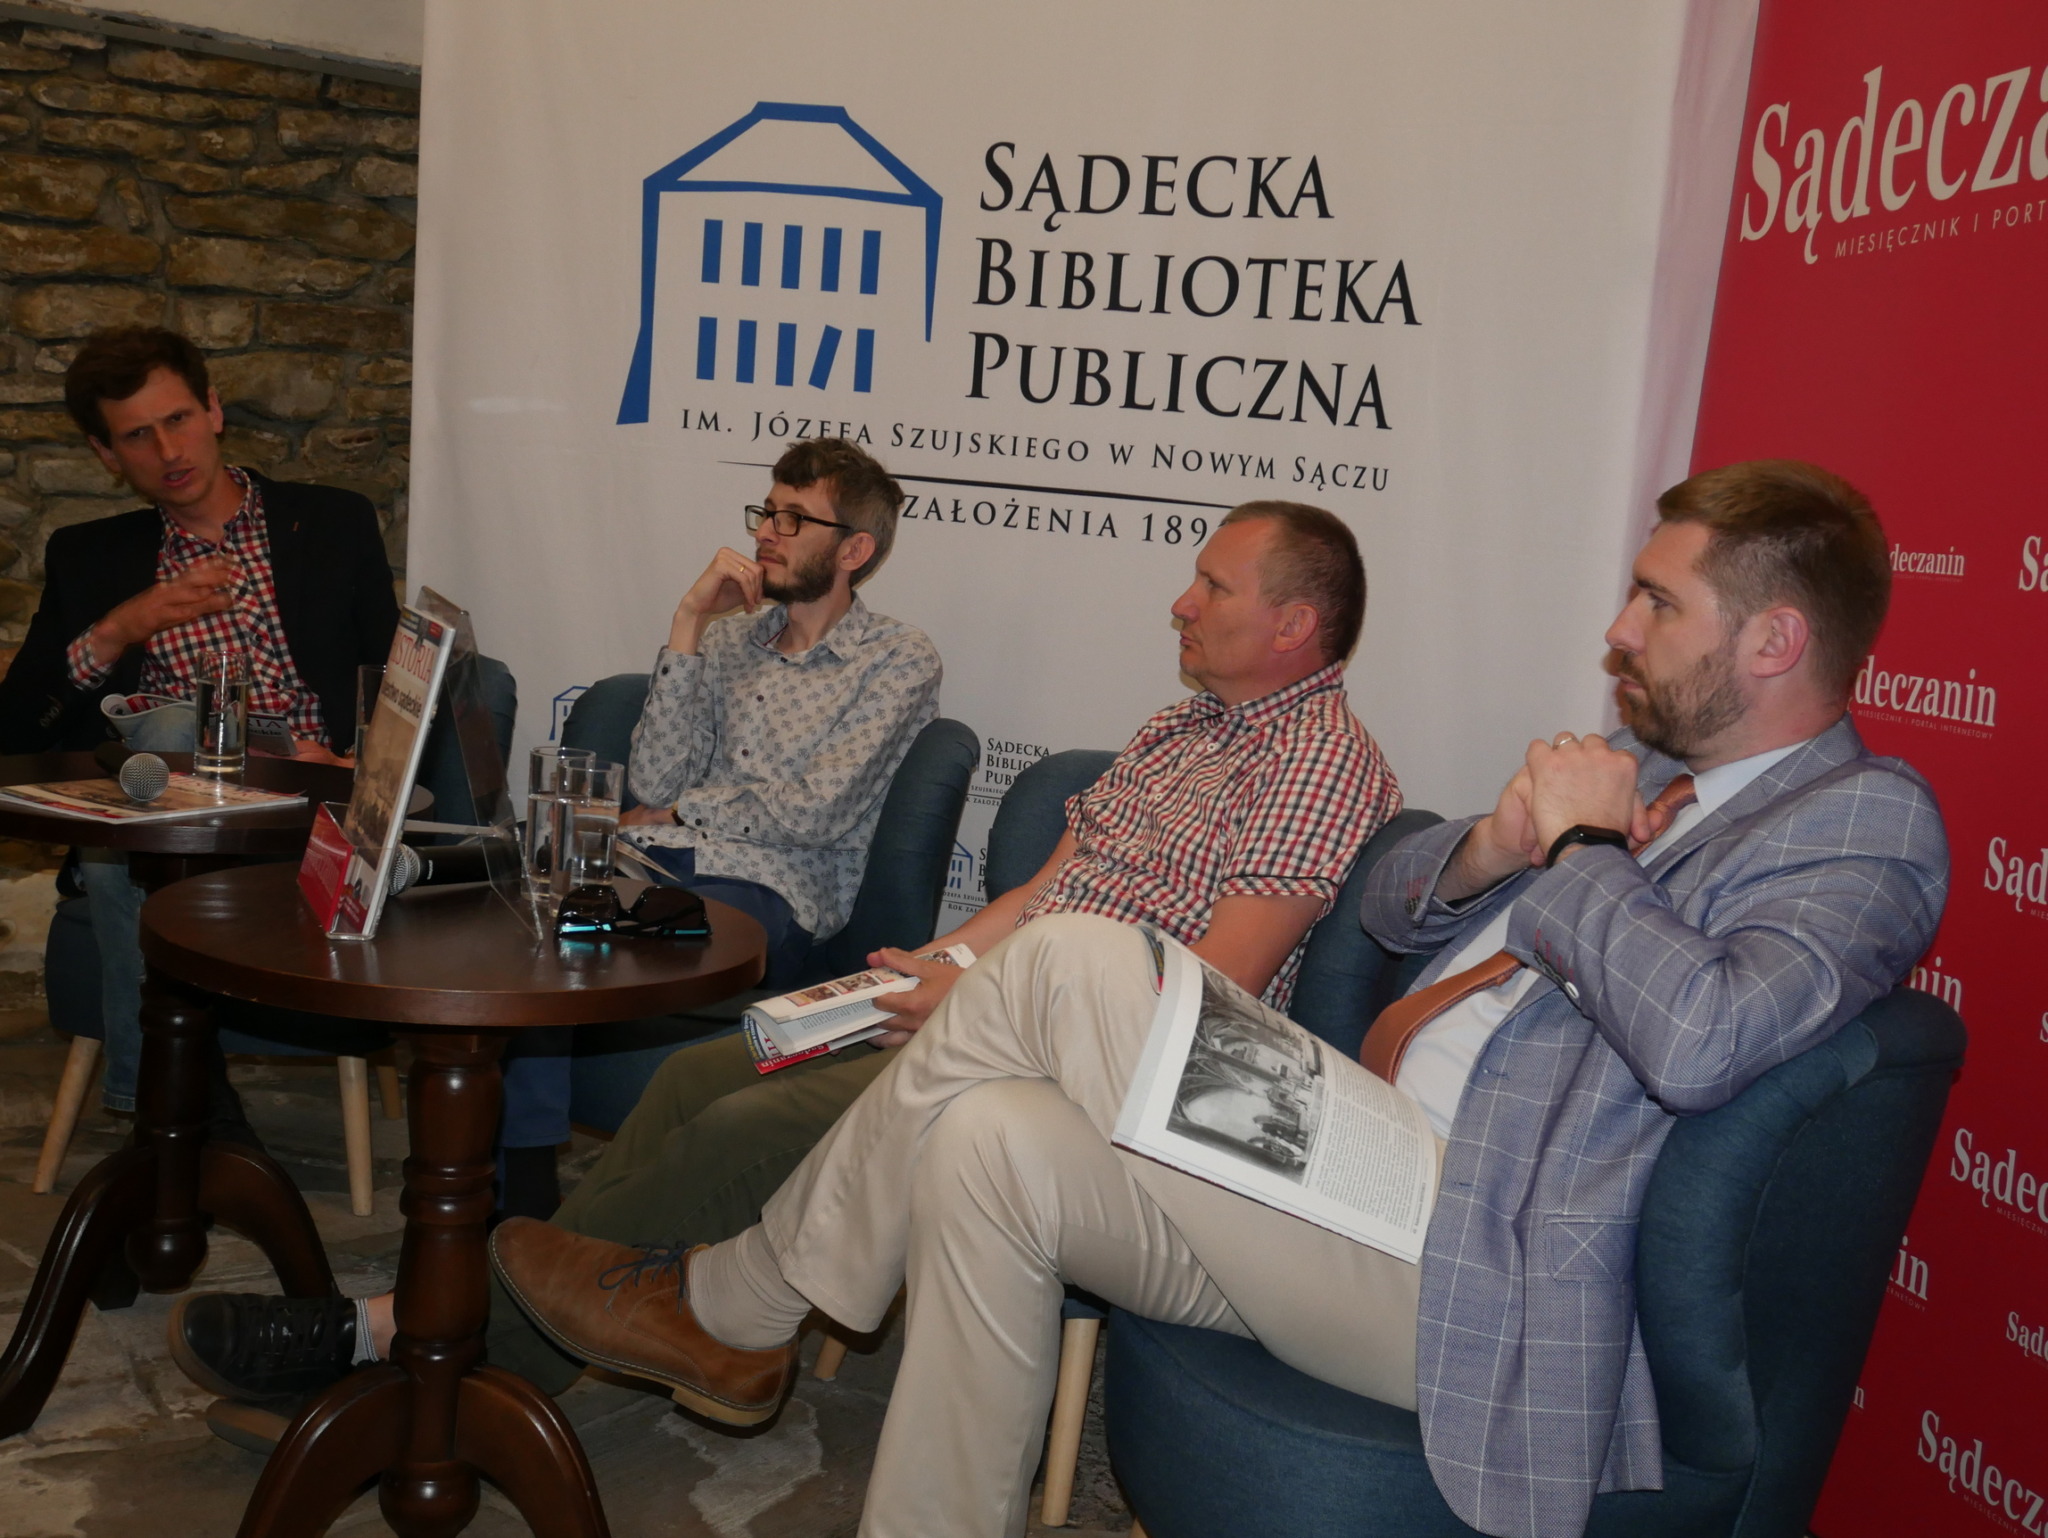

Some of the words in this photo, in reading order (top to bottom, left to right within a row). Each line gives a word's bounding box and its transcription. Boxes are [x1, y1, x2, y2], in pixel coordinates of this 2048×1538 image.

[979, 141, 1335, 233] SĄDECKA
[1834, 215, 1961, 259] MIESIĘCZNIK
[1972, 212, 1979, 233] I
[1992, 199, 2047, 230] PORT
[972, 237, 1423, 328] BIBLIOTEKA
[965, 331, 1394, 431] PUBLICZNA
[681, 408, 732, 433] IM.
[751, 410, 873, 444] JÓZEFA
[891, 422, 1090, 463] SZUJSKIEGO
[1108, 443, 1134, 466] W
[1151, 443, 1276, 481] NOWYM
[1292, 455, 1390, 493] SĄCZU
[902, 494, 1119, 539] ZAŁOŻENIA
[1141, 512, 1226, 548] 189
[1889, 543, 1965, 577] deczanin
[1850, 655, 1997, 728] deczanin
[986, 737, 1050, 757] SĄDECKA
[986, 753, 1033, 771] BIBLIO
[973, 797, 1000, 806] ZAŁOŻE
[1917, 1409, 2048, 1538] Sądecz
